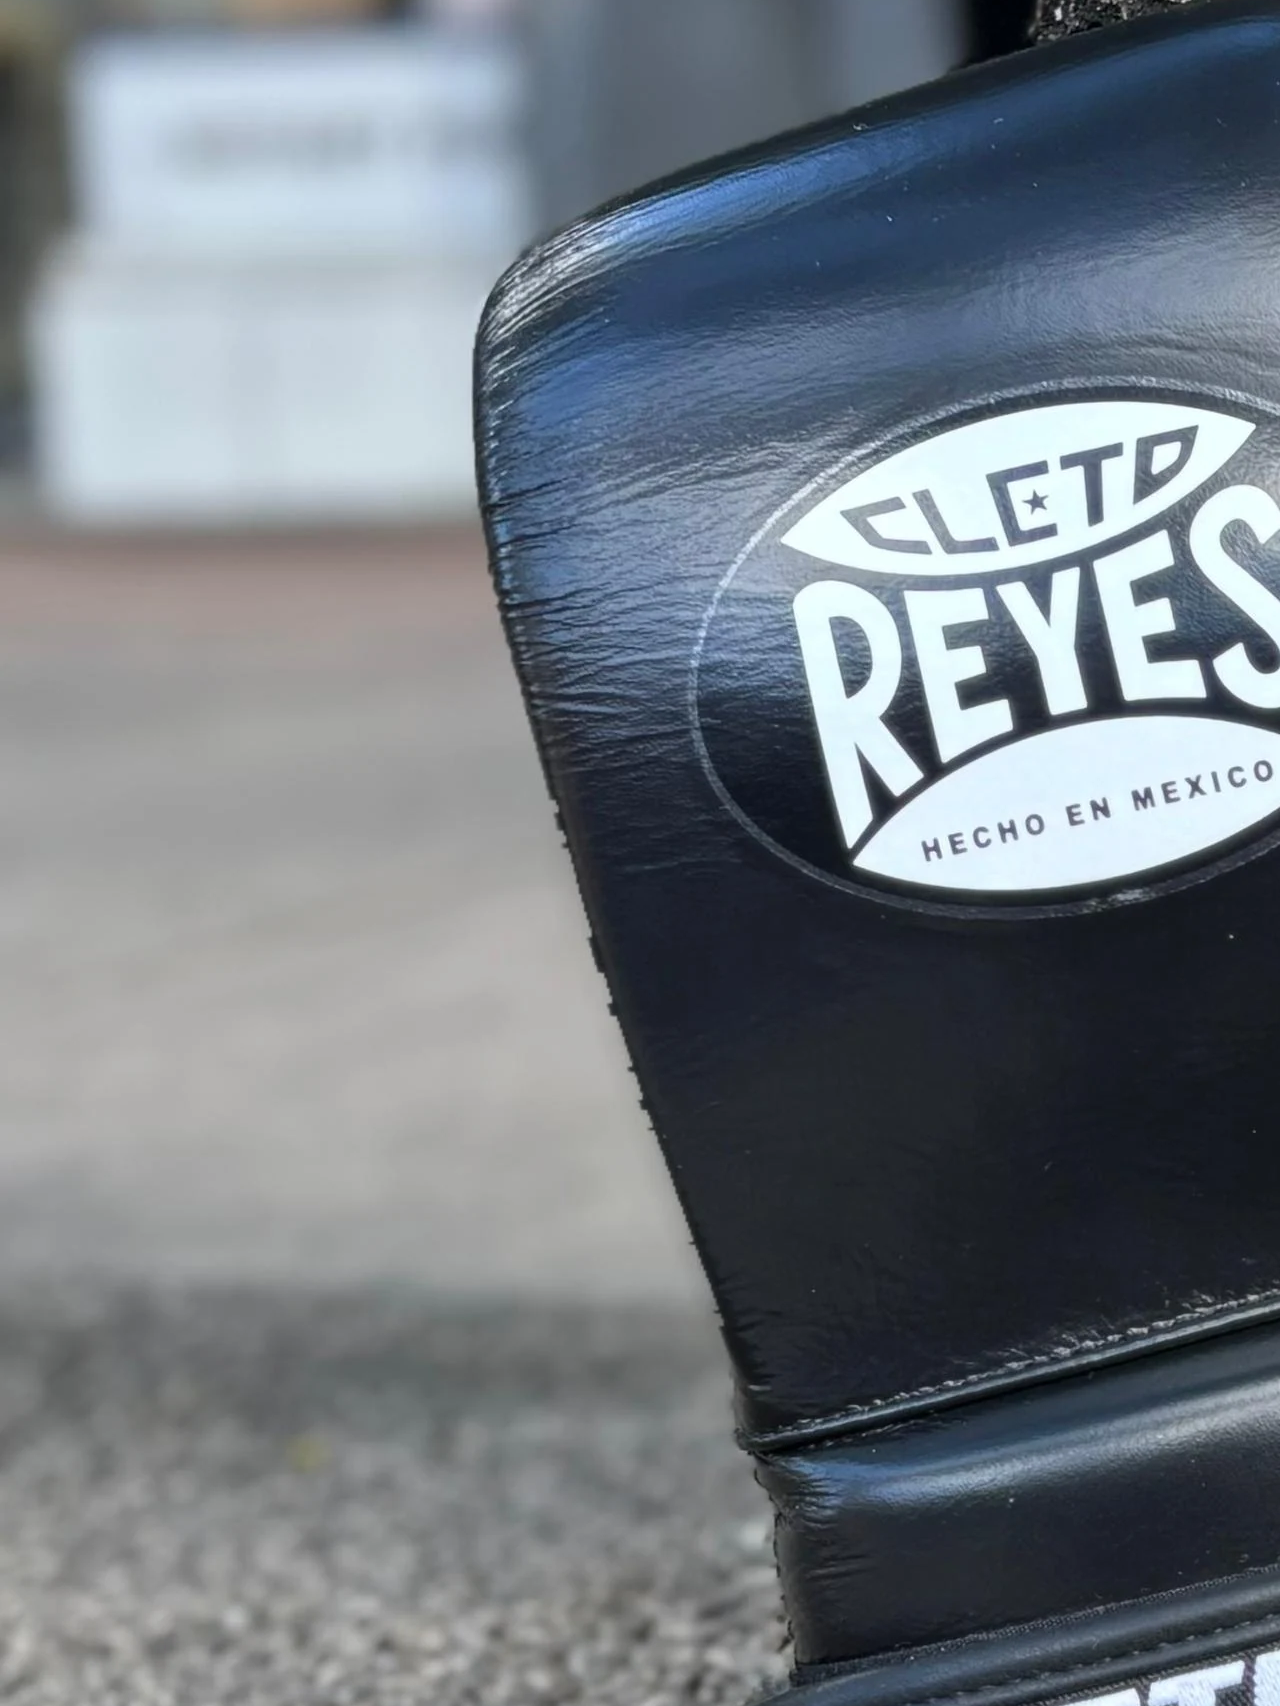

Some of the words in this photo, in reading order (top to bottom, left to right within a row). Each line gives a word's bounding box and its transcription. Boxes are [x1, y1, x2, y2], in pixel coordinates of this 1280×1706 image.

[840, 424, 1200, 556] CLETO
[921, 812, 1046, 863] HECHO
[1065, 795, 1111, 827] EN
[1131, 758, 1276, 813] MEXICO
